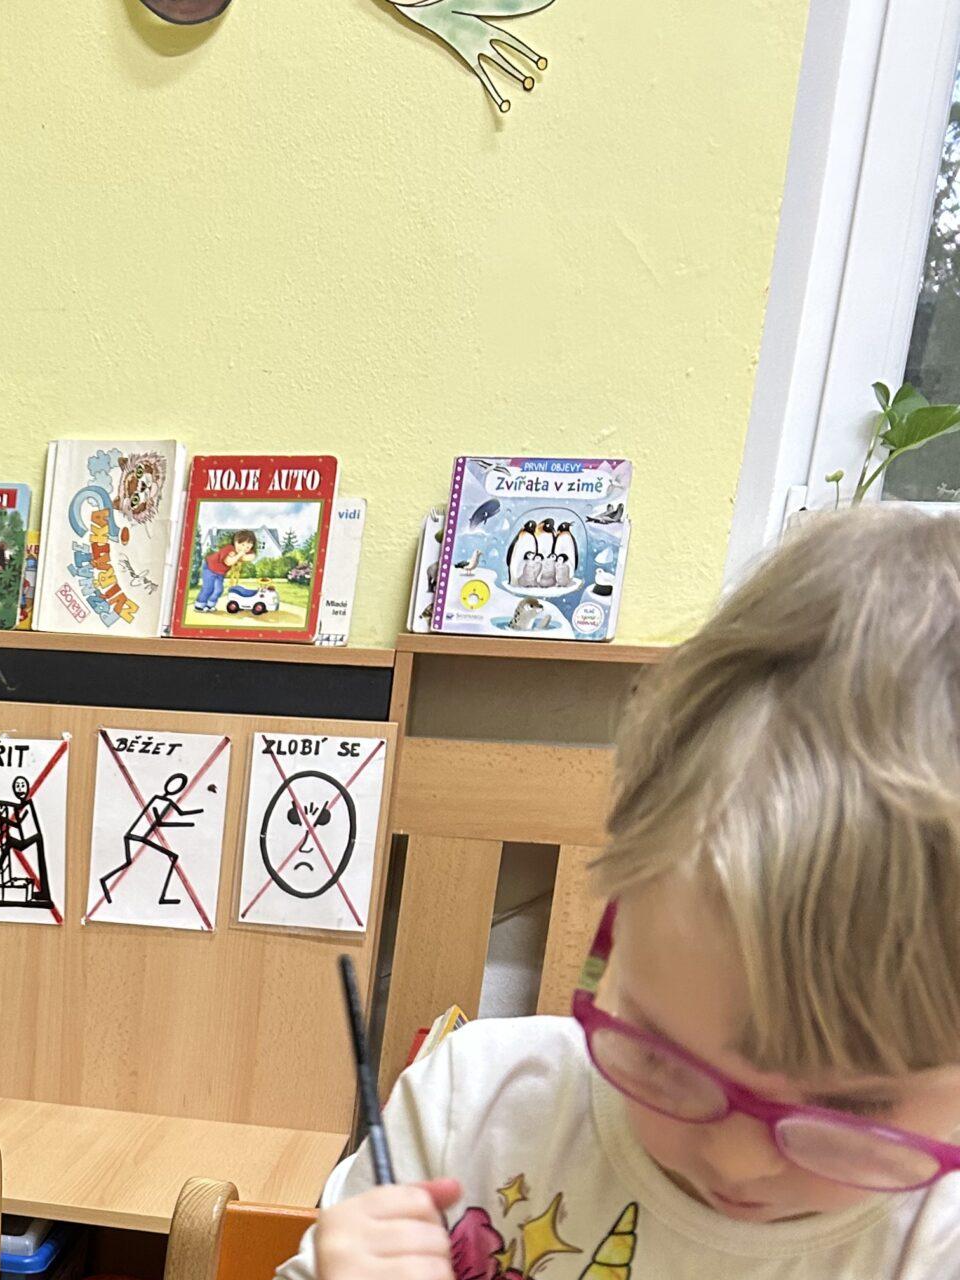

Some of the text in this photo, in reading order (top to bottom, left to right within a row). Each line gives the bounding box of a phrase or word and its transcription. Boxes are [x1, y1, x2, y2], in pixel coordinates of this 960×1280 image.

[524, 461, 581, 473] PRVNÍ OBJEVY
[204, 469, 320, 490] MOJE AUTO
[495, 475, 603, 493] Zvířata v zimě
[114, 736, 183, 756] BĚŽET
[337, 741, 360, 757] SE
